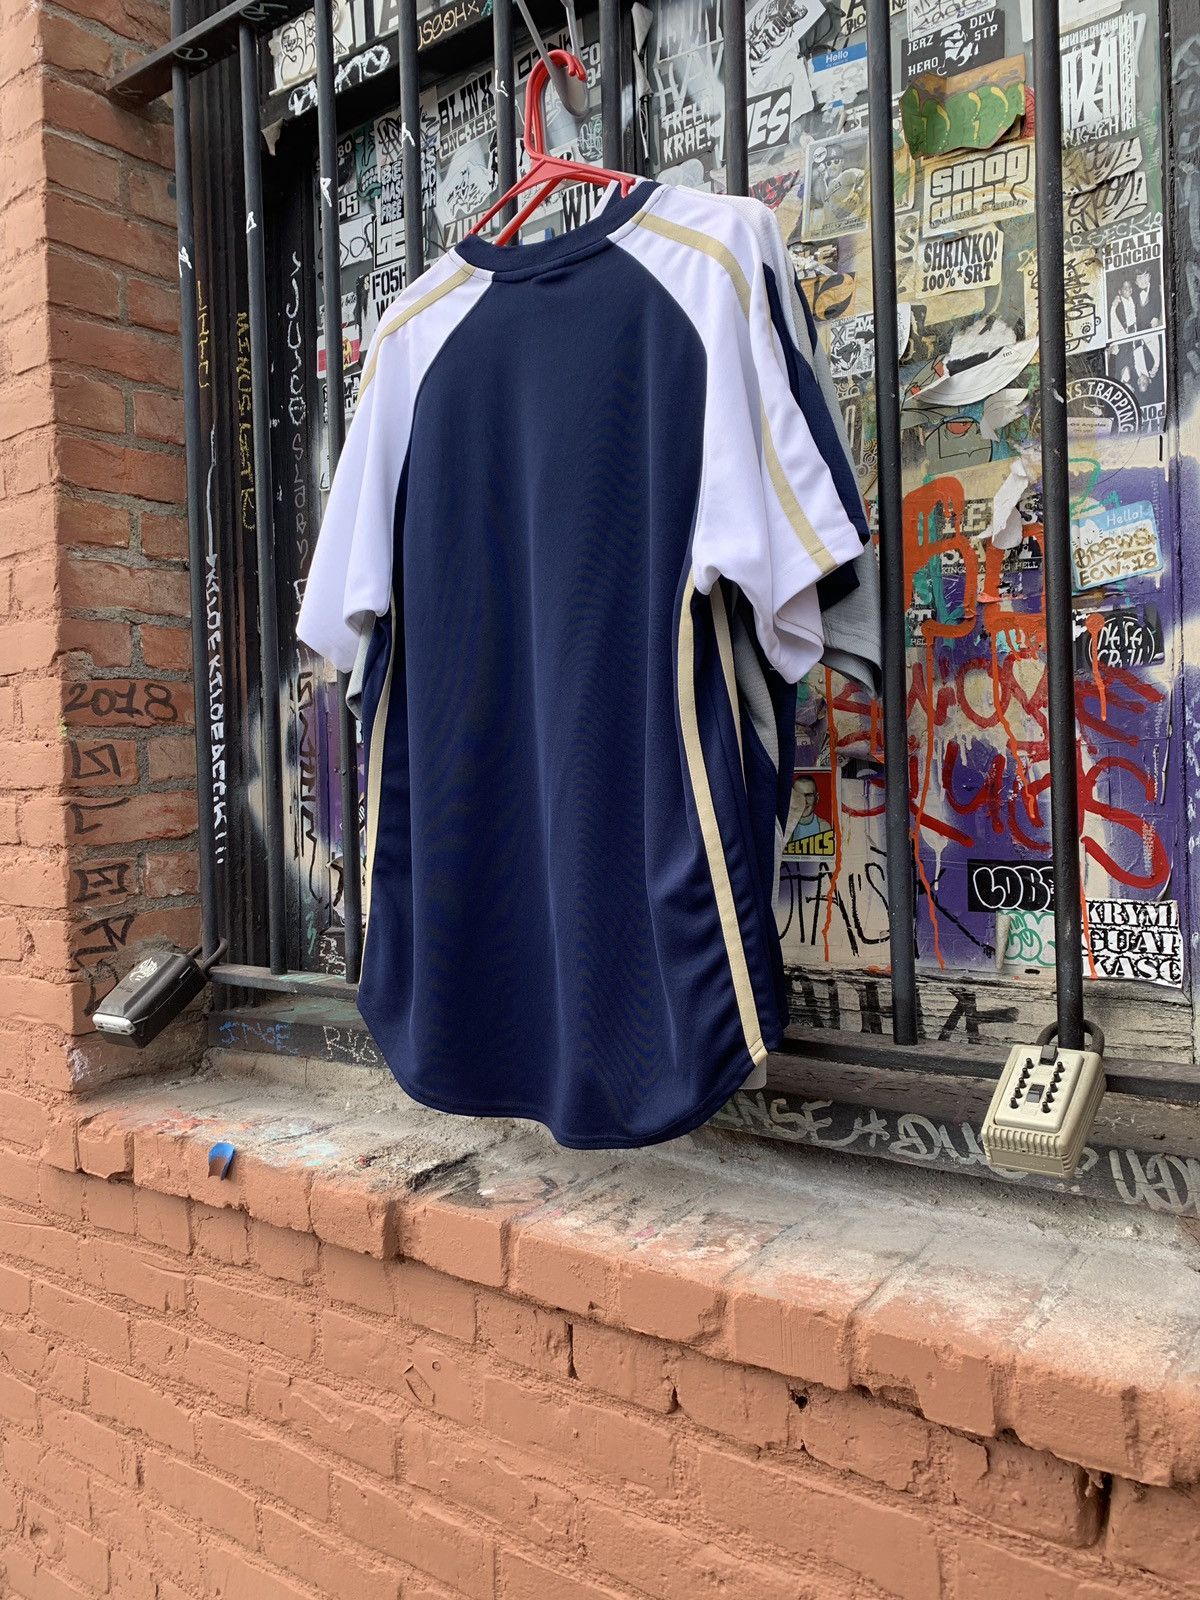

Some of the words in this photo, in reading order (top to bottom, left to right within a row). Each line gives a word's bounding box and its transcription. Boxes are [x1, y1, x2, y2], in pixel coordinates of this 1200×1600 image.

[970, 10, 996, 29] DCV
[974, 24, 999, 42] STP
[907, 34, 935, 56] JERZ
[825, 51, 849, 64] Hello
[908, 56, 940, 77] HERO
[1104, 243, 1161, 271] PONCHO
[1087, 381, 1135, 433] TRAPPING
[63, 680, 178, 723] 2018
